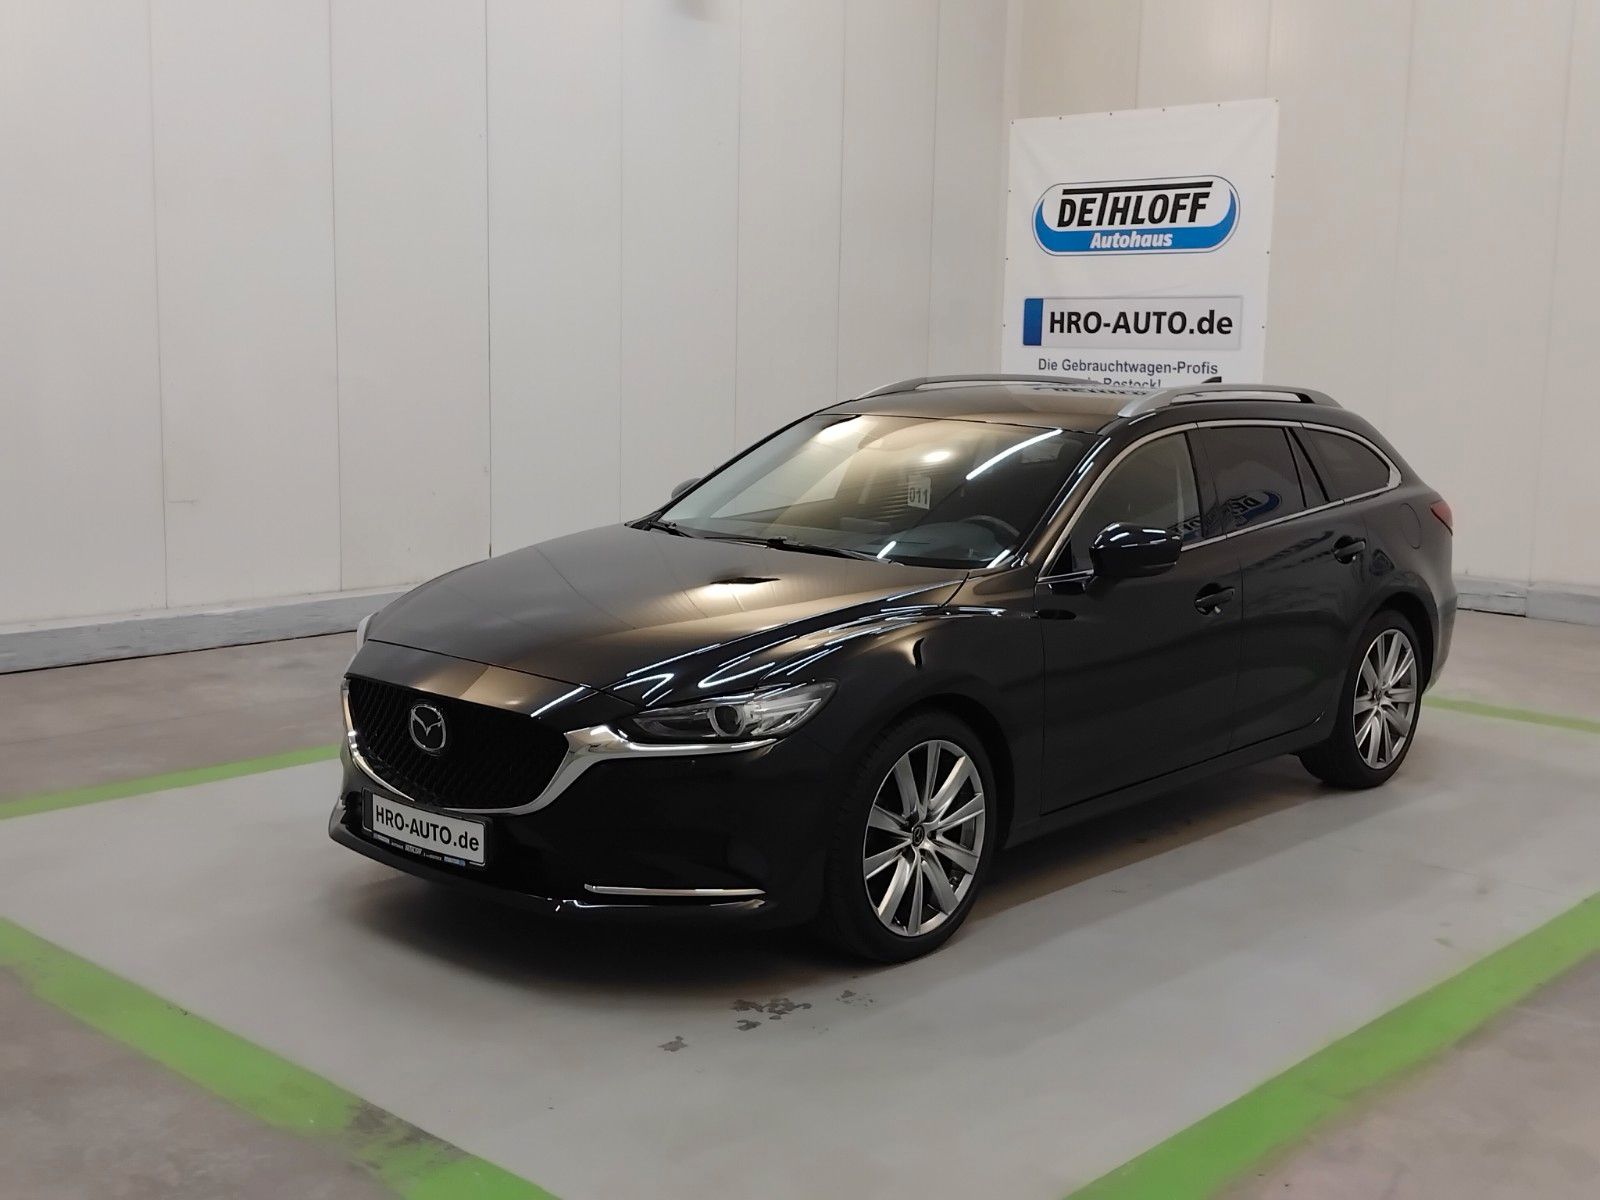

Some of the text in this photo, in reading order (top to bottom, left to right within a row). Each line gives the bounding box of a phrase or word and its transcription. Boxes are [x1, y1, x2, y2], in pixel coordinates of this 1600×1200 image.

[1057, 181, 1214, 228] DETHLOFF
[1089, 230, 1173, 249] Autohaus
[1049, 309, 1234, 335] HRO-AUTO.de
[1037, 358, 1218, 376] Die Gebrauchtwagen-Profis
[375, 804, 480, 852] HRO-AUTO.de
